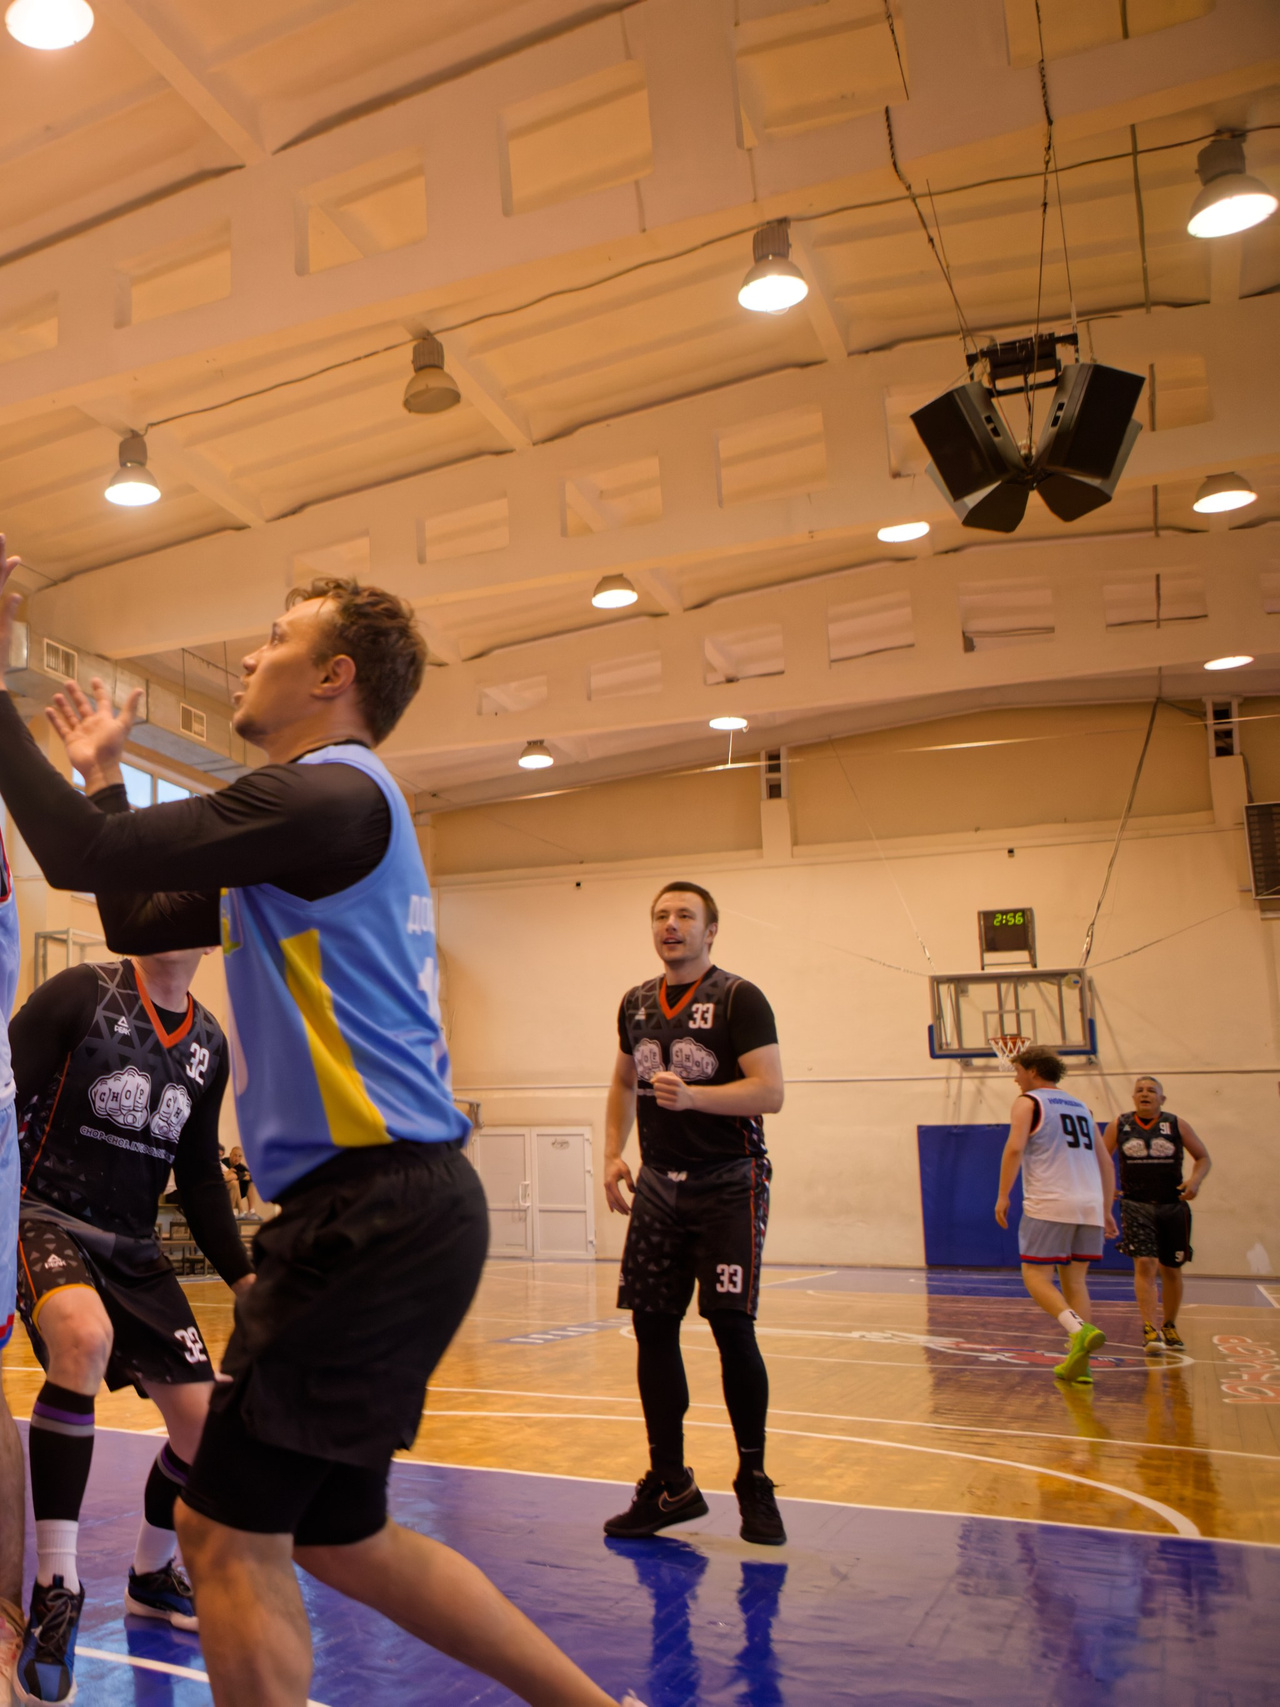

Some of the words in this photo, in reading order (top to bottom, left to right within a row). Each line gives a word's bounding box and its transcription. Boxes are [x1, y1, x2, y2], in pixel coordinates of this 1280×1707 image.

[993, 911, 1024, 926] 2:56
[688, 1002, 715, 1029] 33
[185, 1042, 210, 1086] 32
[99, 1088, 145, 1103] CHOP
[1060, 1113, 1093, 1151] 99
[1159, 1121, 1172, 1135] 91
[716, 1263, 743, 1293] 33
[174, 1326, 208, 1364] 32
